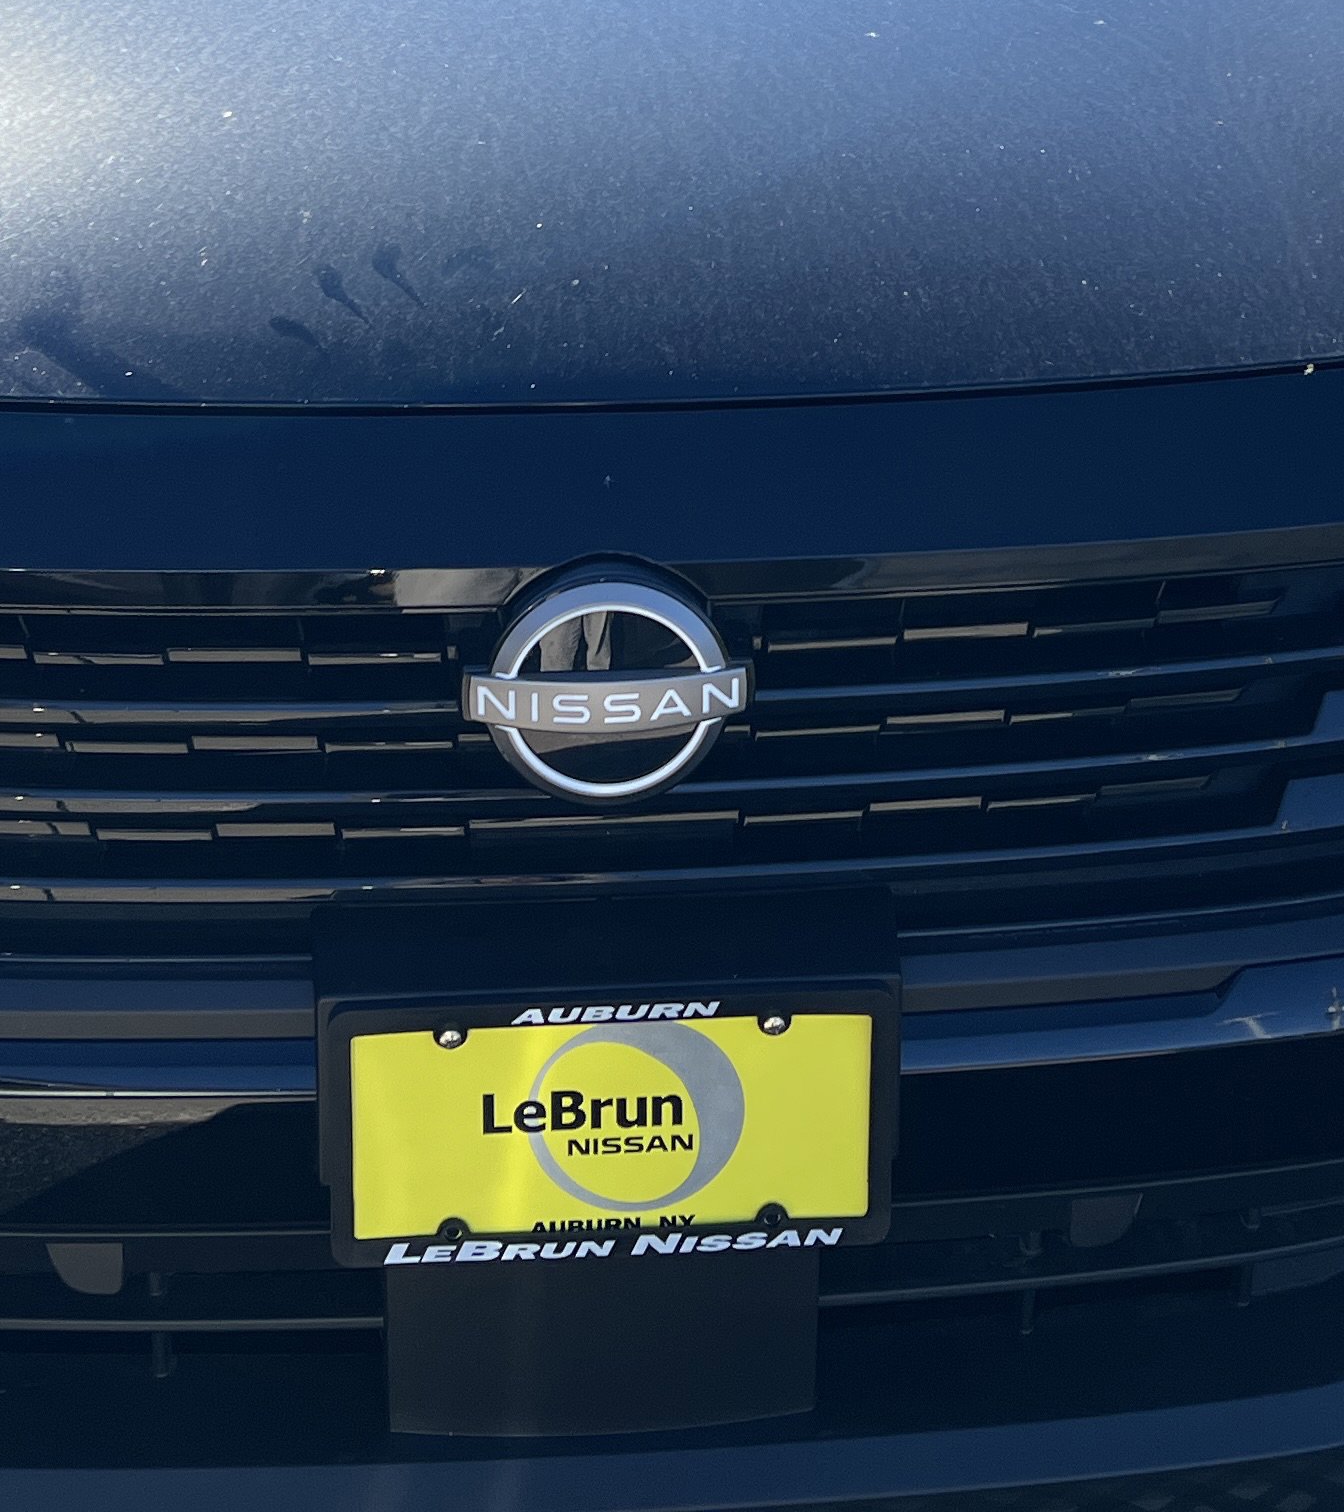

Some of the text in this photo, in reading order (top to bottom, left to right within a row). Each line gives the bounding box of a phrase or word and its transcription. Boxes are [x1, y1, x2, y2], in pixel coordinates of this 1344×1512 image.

[476, 678, 739, 724] NISSAN
[511, 1001, 720, 1025] AUBURN
[482, 1091, 683, 1135] LeBrun
[567, 1134, 694, 1156] NISSAN
